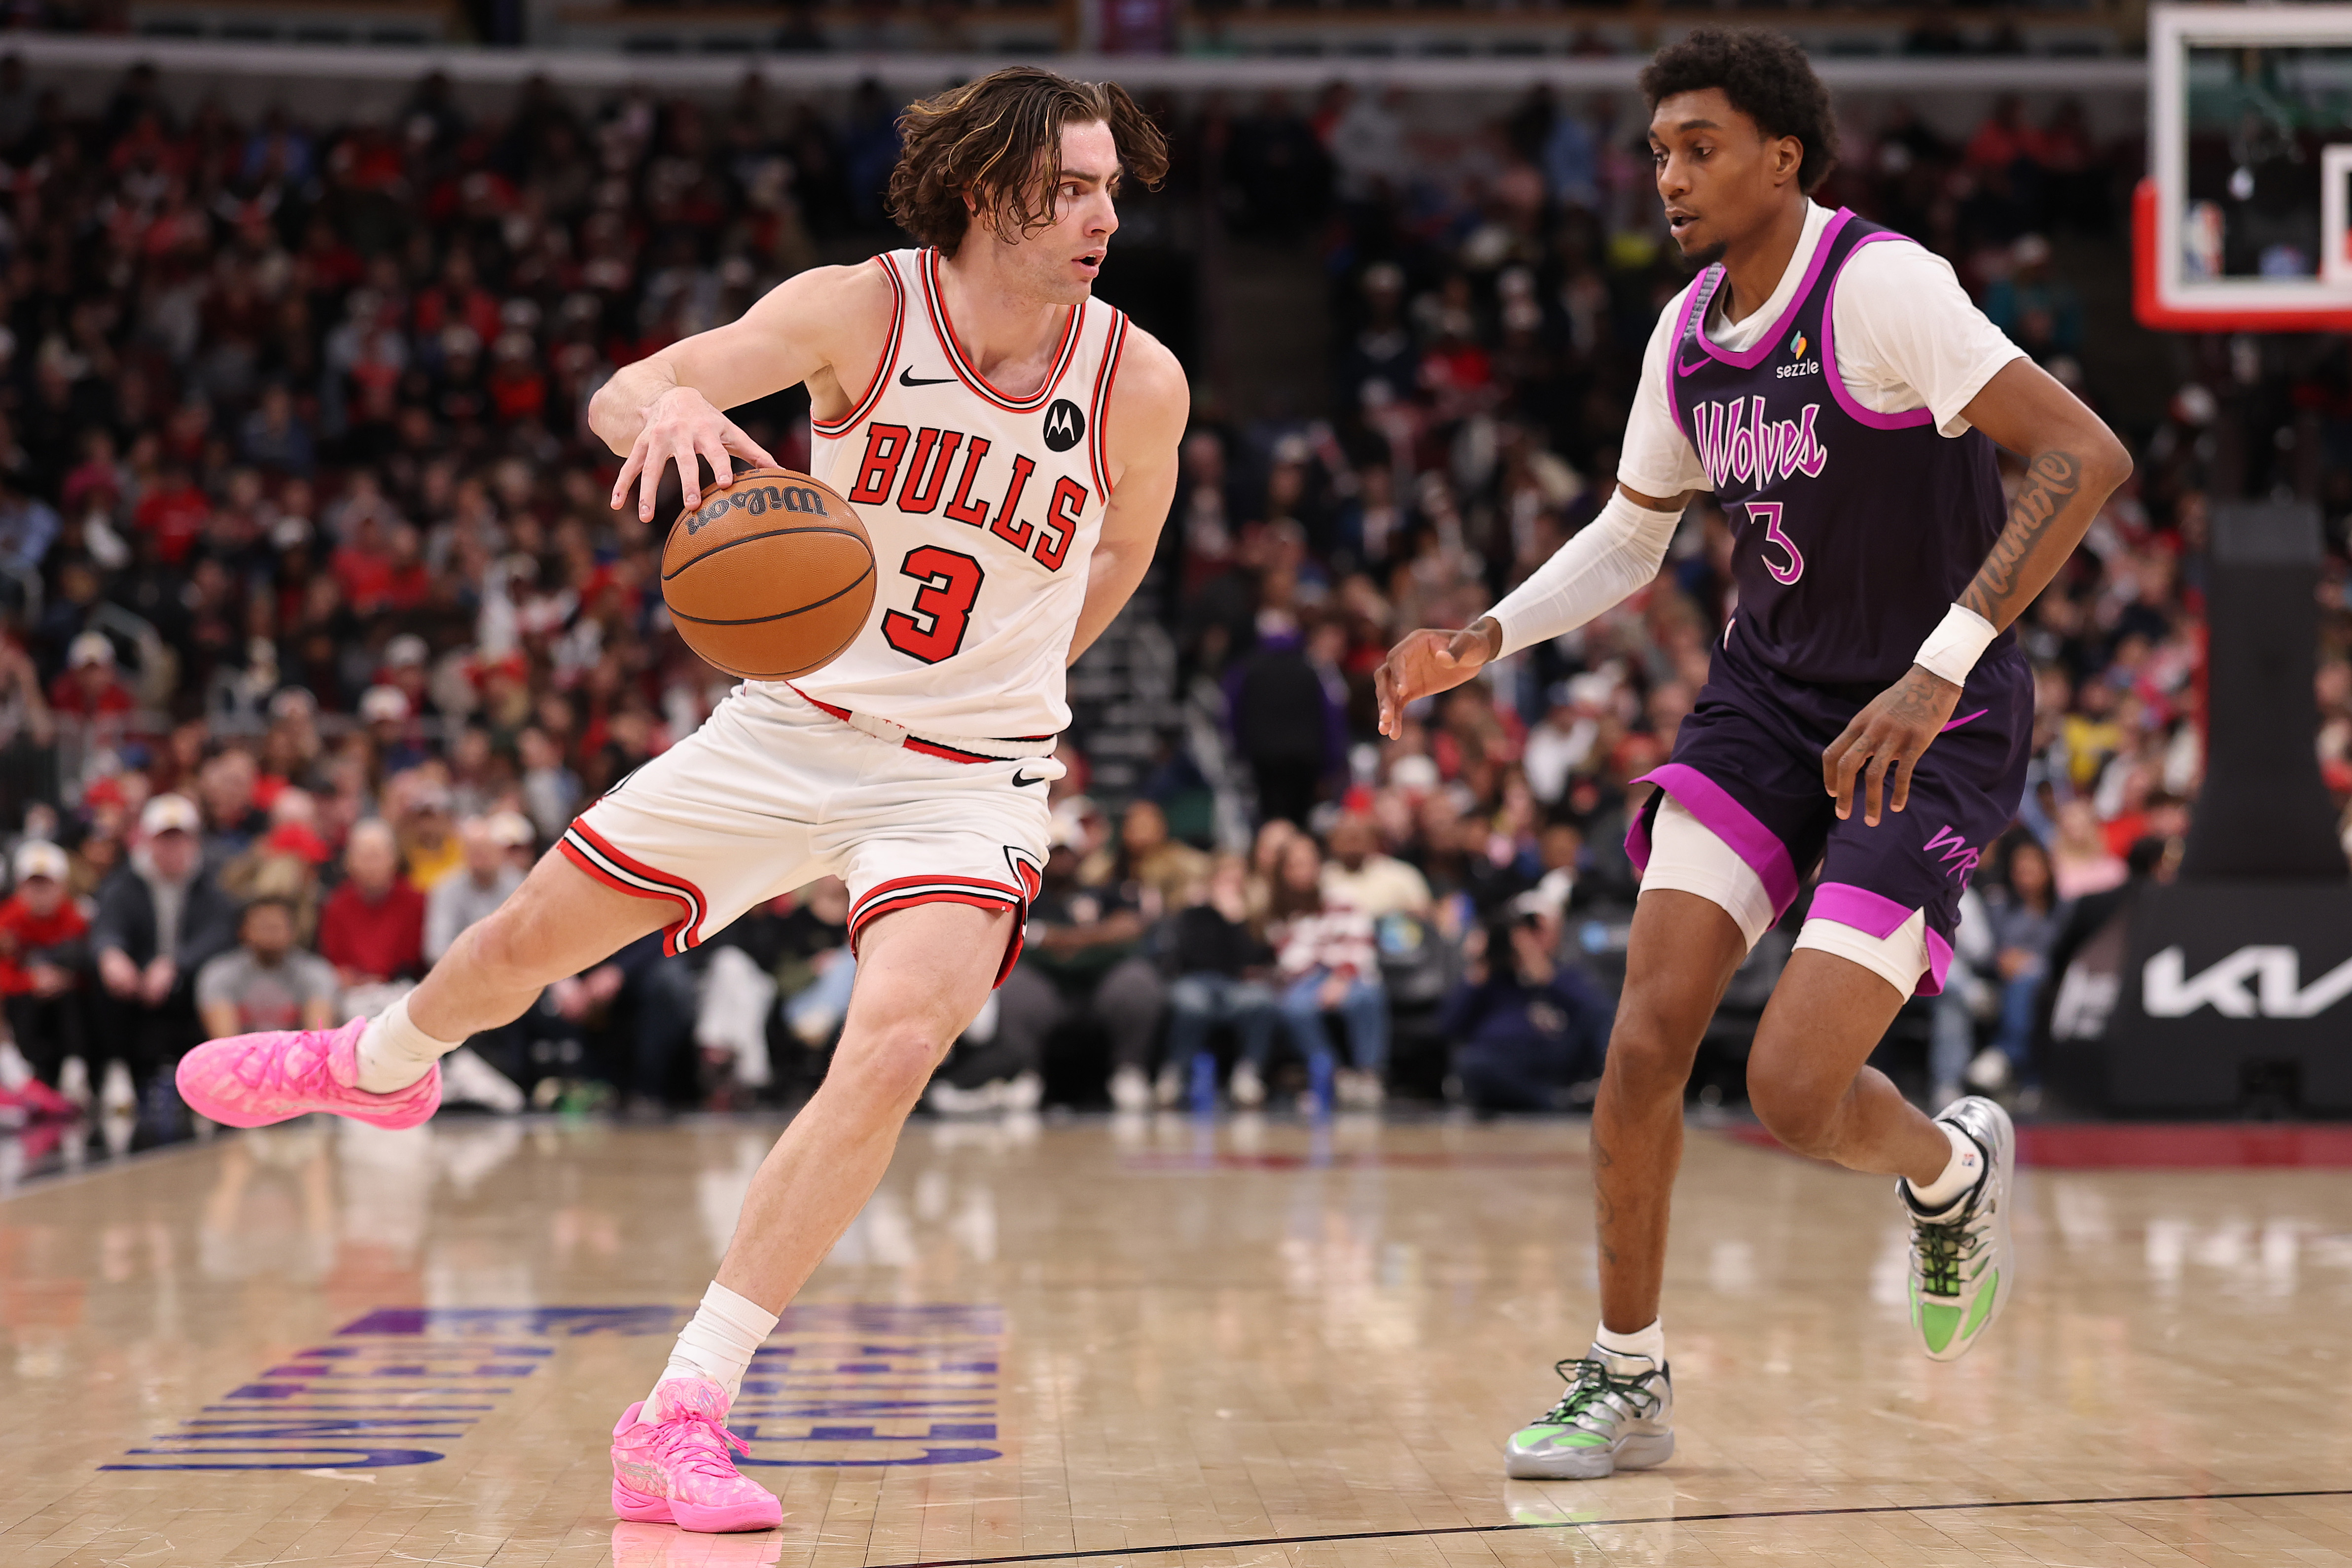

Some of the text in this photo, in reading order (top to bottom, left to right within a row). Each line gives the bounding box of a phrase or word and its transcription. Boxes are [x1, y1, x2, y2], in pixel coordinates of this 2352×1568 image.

[1776, 358, 1819, 379] sezzle
[1692, 395, 1828, 491] Wolves
[685, 486, 829, 535] Wilson
[848, 422, 1089, 572] BULLS
[1744, 501, 1805, 585] 3
[881, 544, 985, 665] 3
